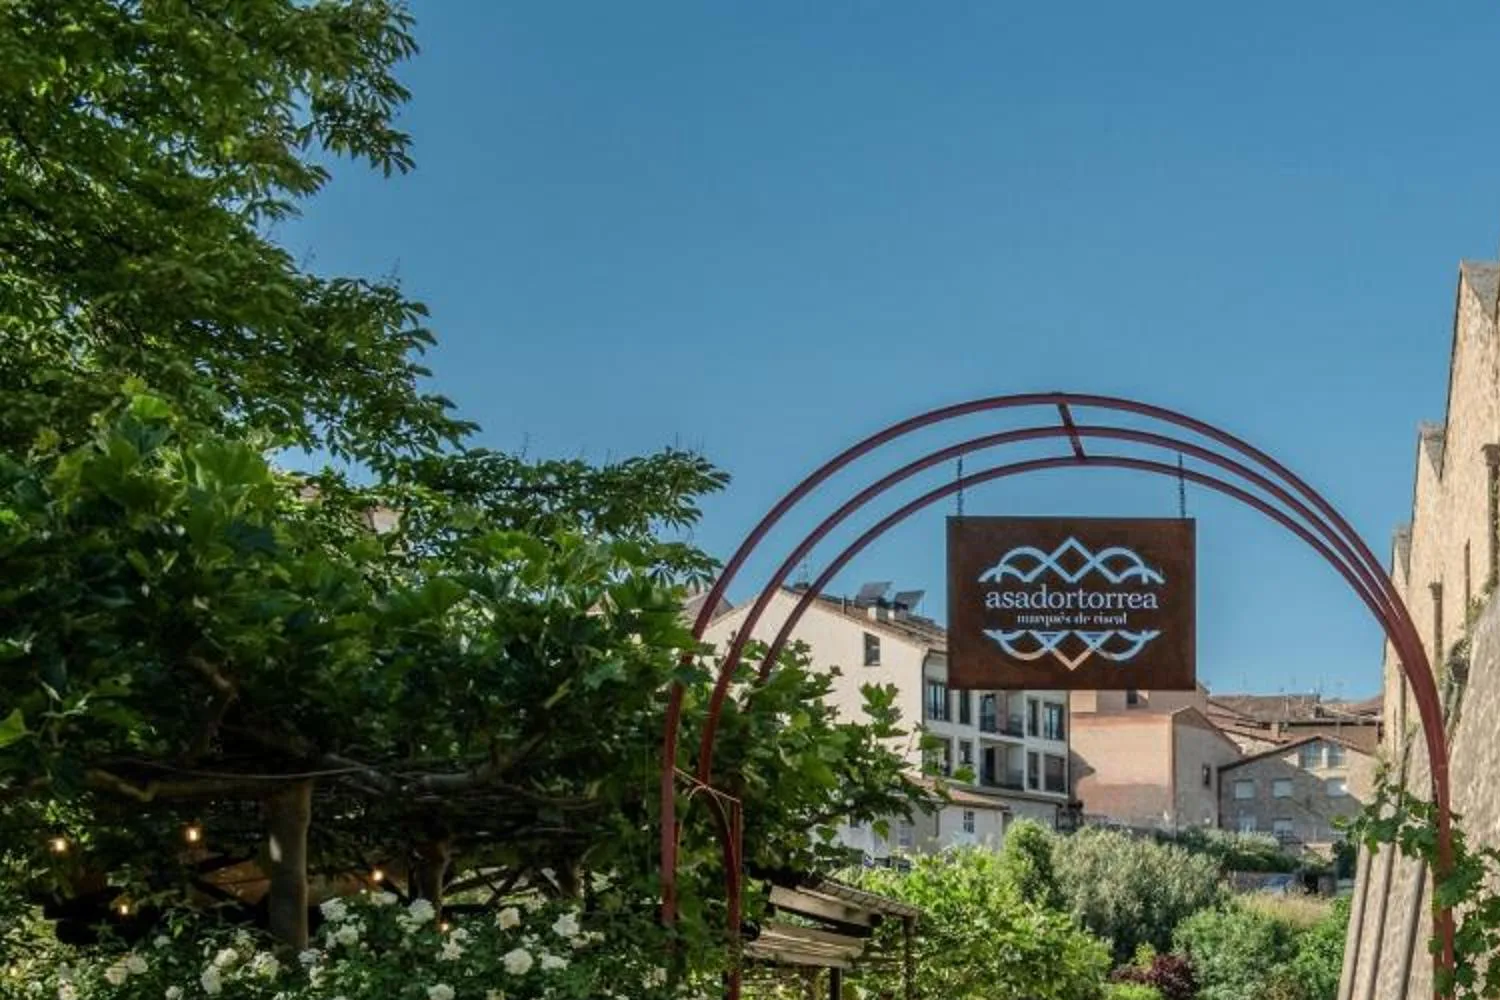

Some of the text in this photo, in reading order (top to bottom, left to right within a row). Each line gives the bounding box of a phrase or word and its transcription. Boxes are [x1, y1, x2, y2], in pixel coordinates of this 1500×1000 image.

[985, 583, 1158, 609] asadortorrea
[1075, 612, 1091, 625] de
[1093, 612, 1127, 625] riscal
